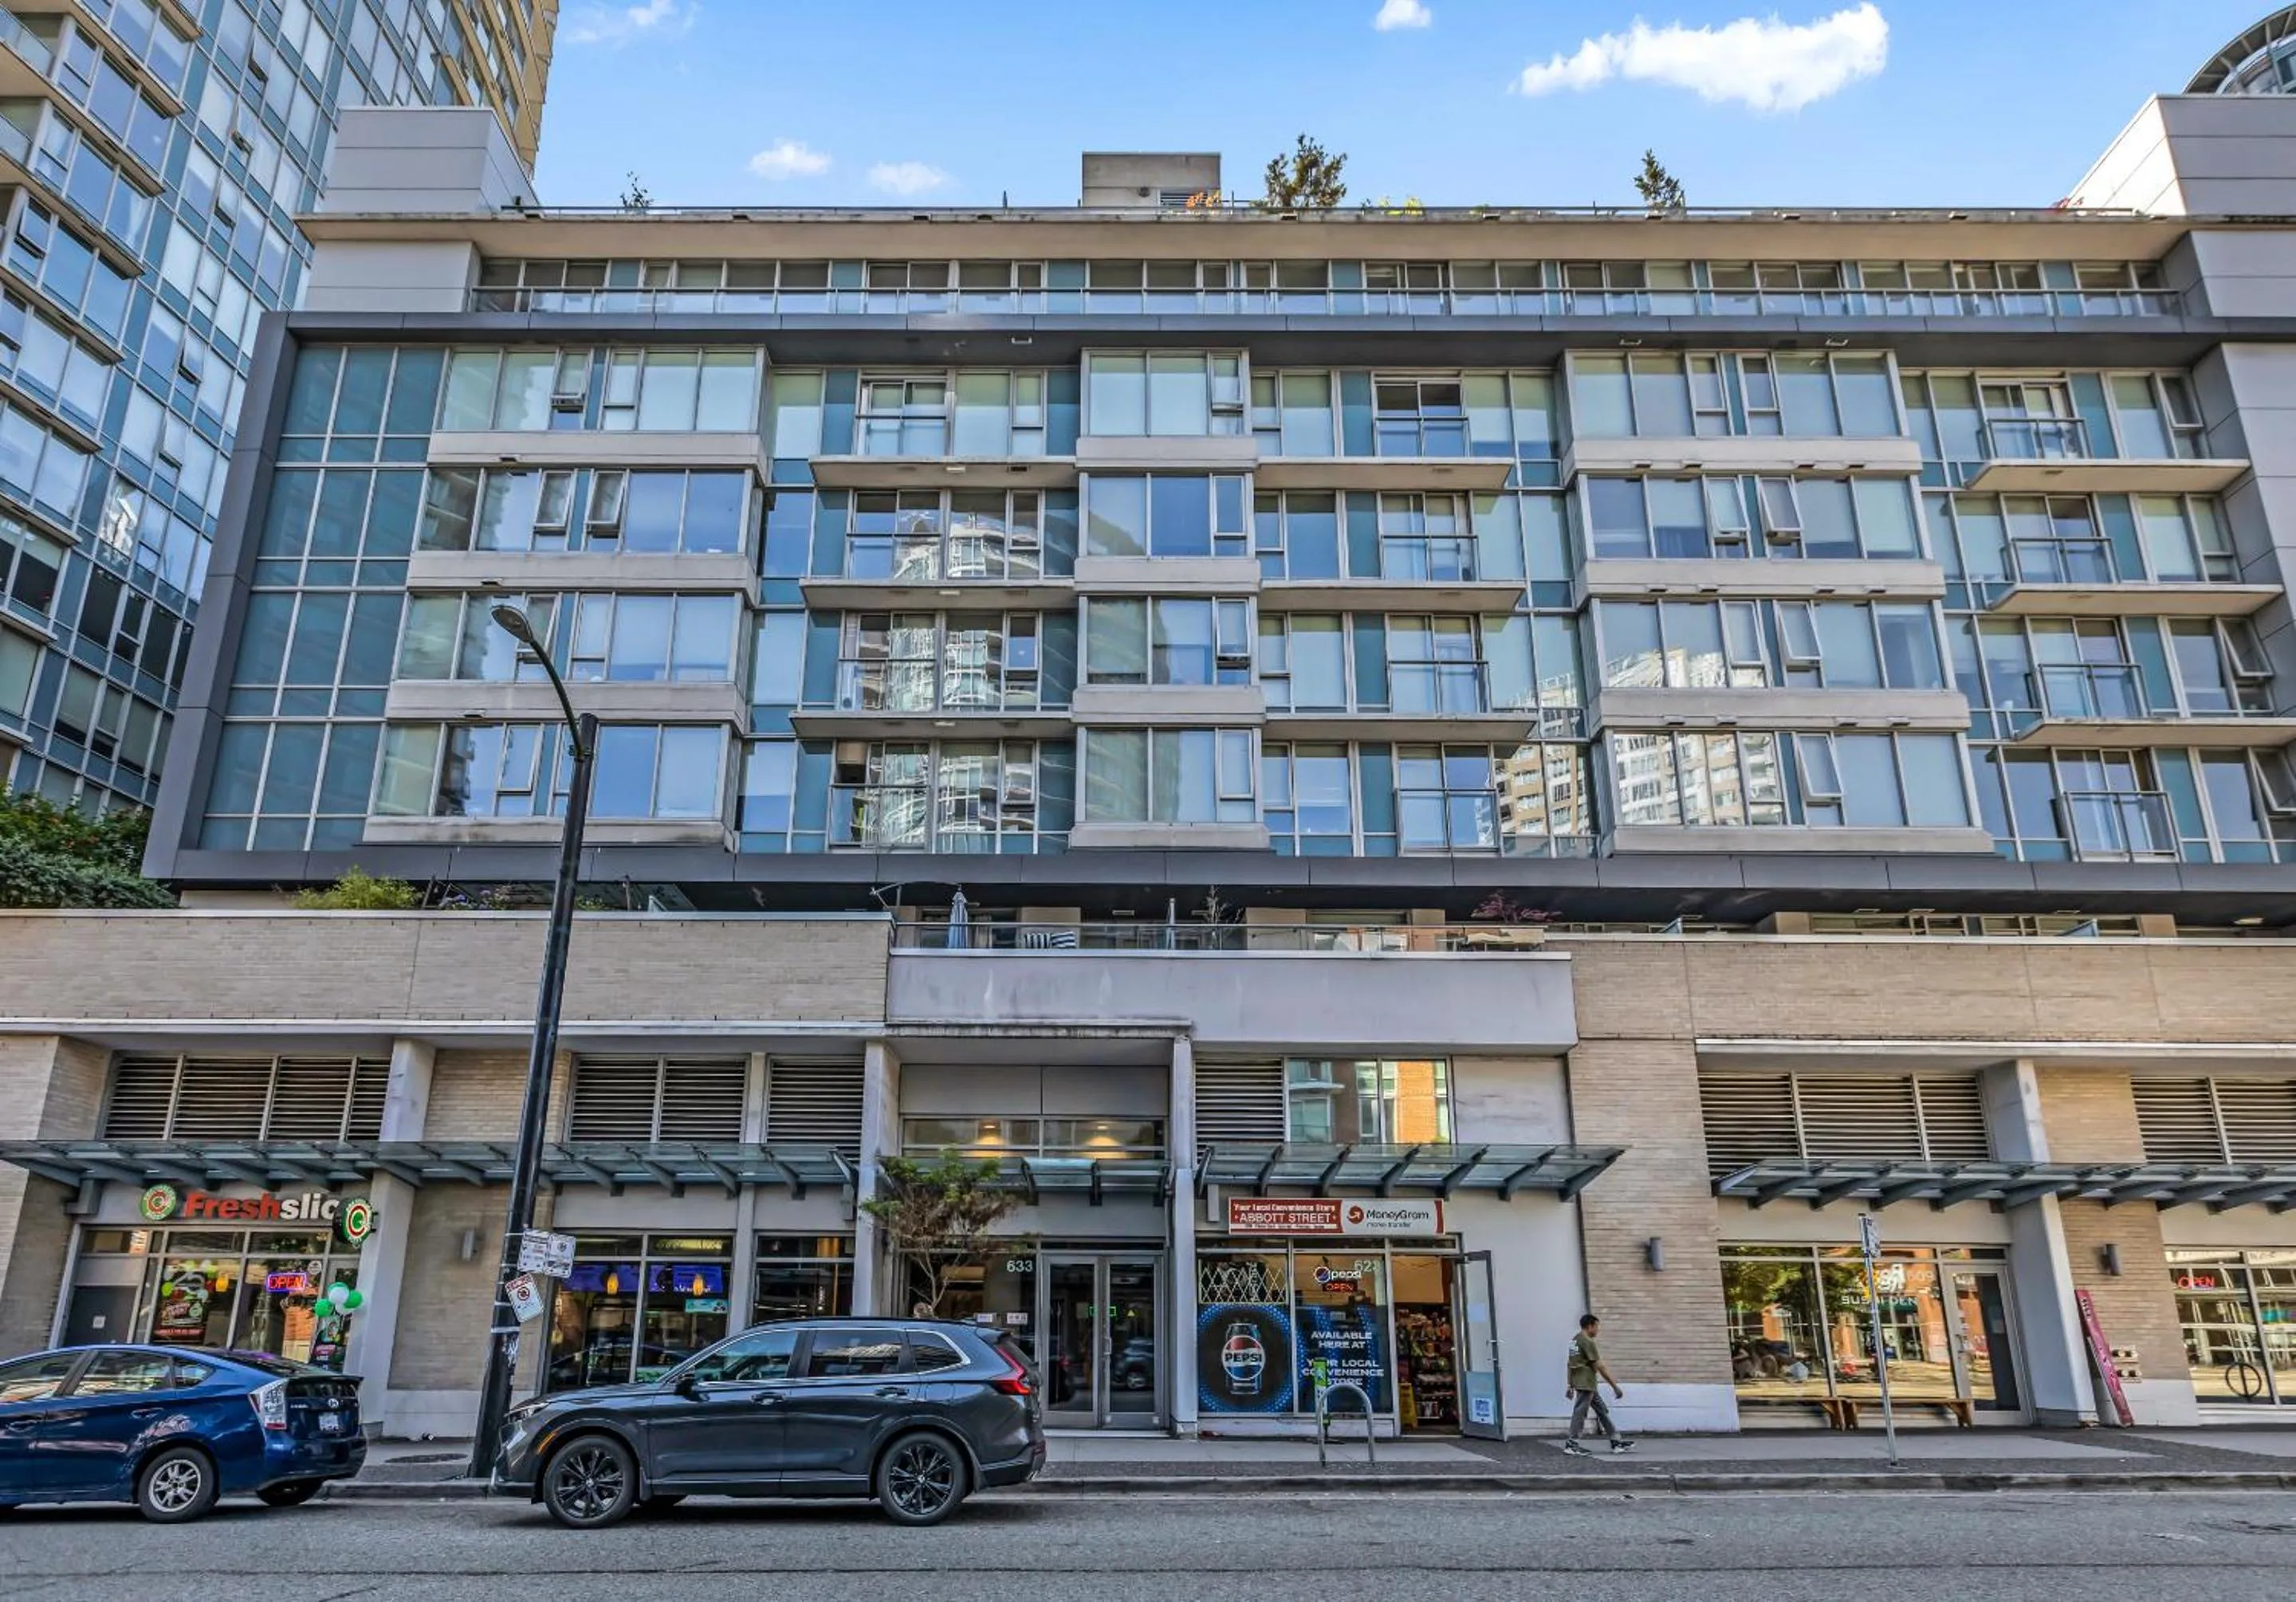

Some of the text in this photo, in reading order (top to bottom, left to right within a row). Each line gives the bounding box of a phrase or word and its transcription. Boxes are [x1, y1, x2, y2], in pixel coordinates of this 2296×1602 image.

[184, 1192, 339, 1220] Freshslic
[1239, 1212, 1331, 1223] ABBOTT STREET
[1366, 1210, 1429, 1221] MoneyGram
[1006, 1260, 1033, 1272] 633
[269, 1277, 305, 1290] OPEN
[2178, 1276, 2215, 1289] OPEN
[1311, 1331, 1372, 1340] AVAILABLE
[1225, 1353, 1262, 1362] PEPSI
[1307, 1358, 1339, 1367] YR
[1302, 1368, 1385, 1376] CVENIENCE
